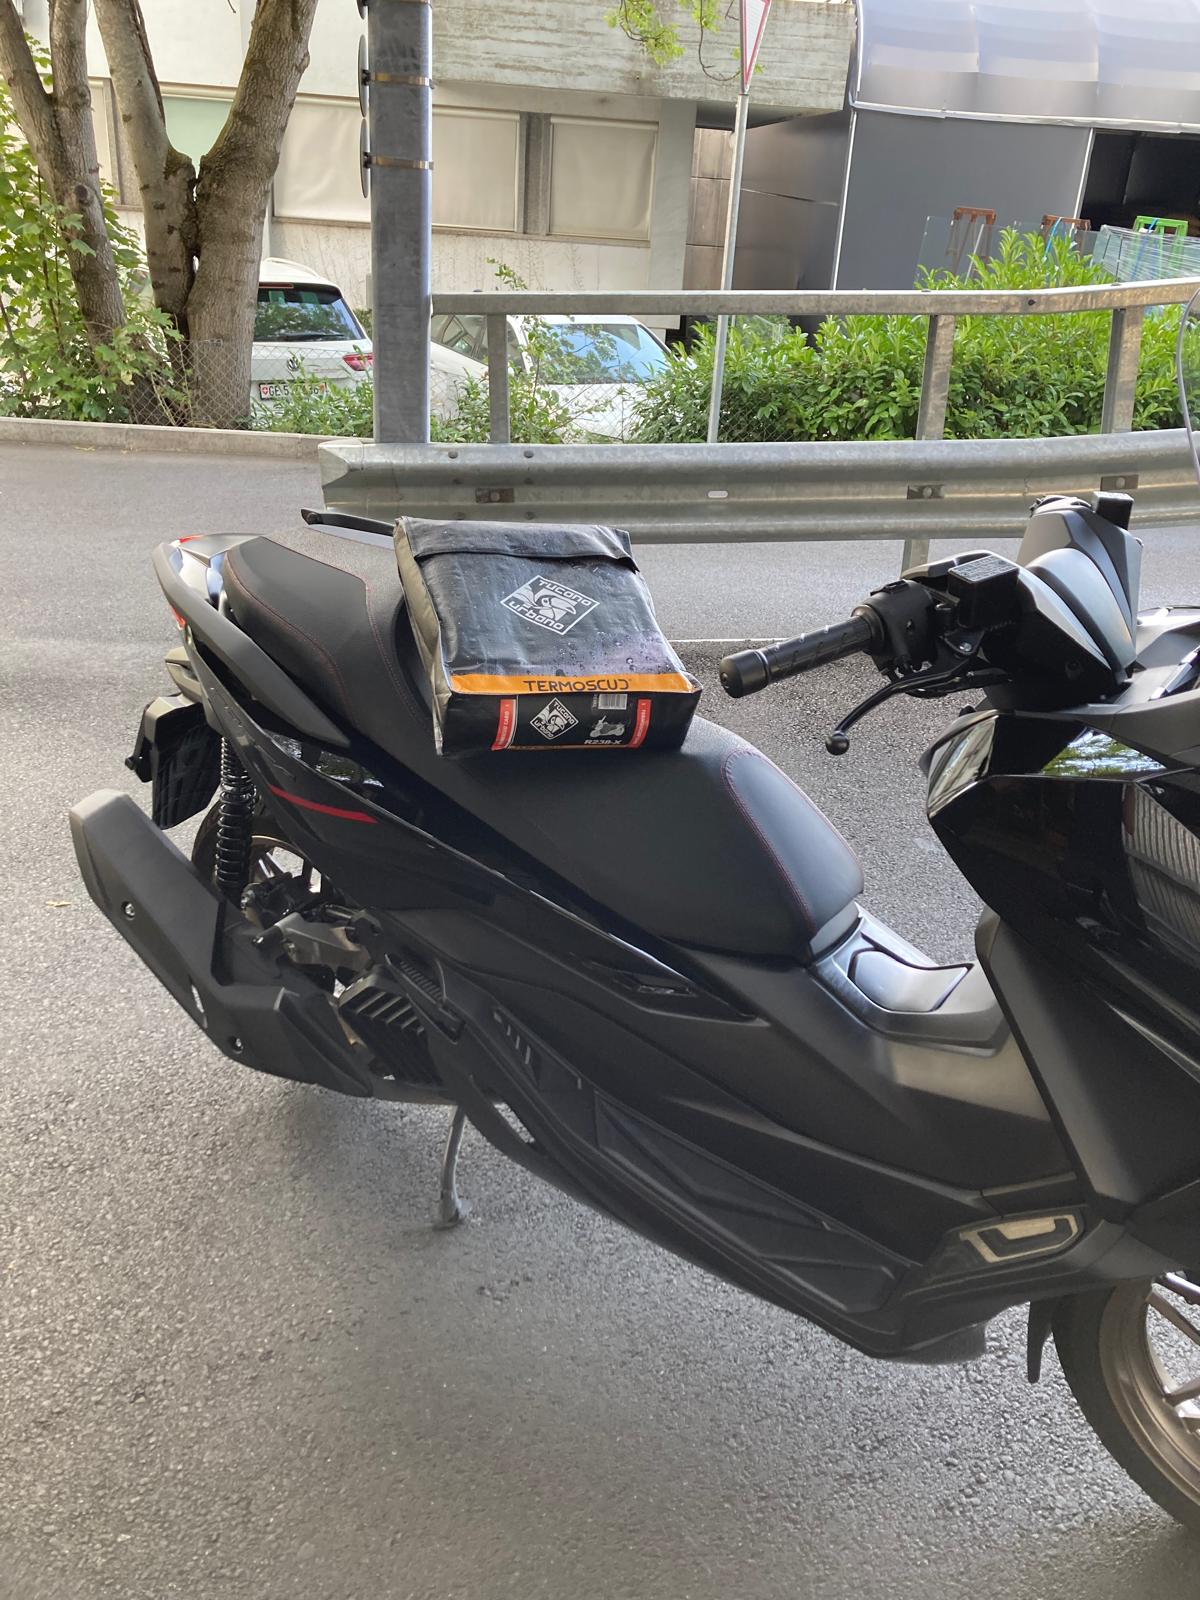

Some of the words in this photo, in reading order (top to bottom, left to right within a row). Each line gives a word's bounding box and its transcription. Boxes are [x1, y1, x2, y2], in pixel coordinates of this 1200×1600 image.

[538, 580, 592, 606] Tucano
[508, 601, 564, 630] urbano
[524, 678, 629, 693] TERMOSCUD
[552, 701, 575, 724] Tucano
[533, 720, 554, 738] urbano
